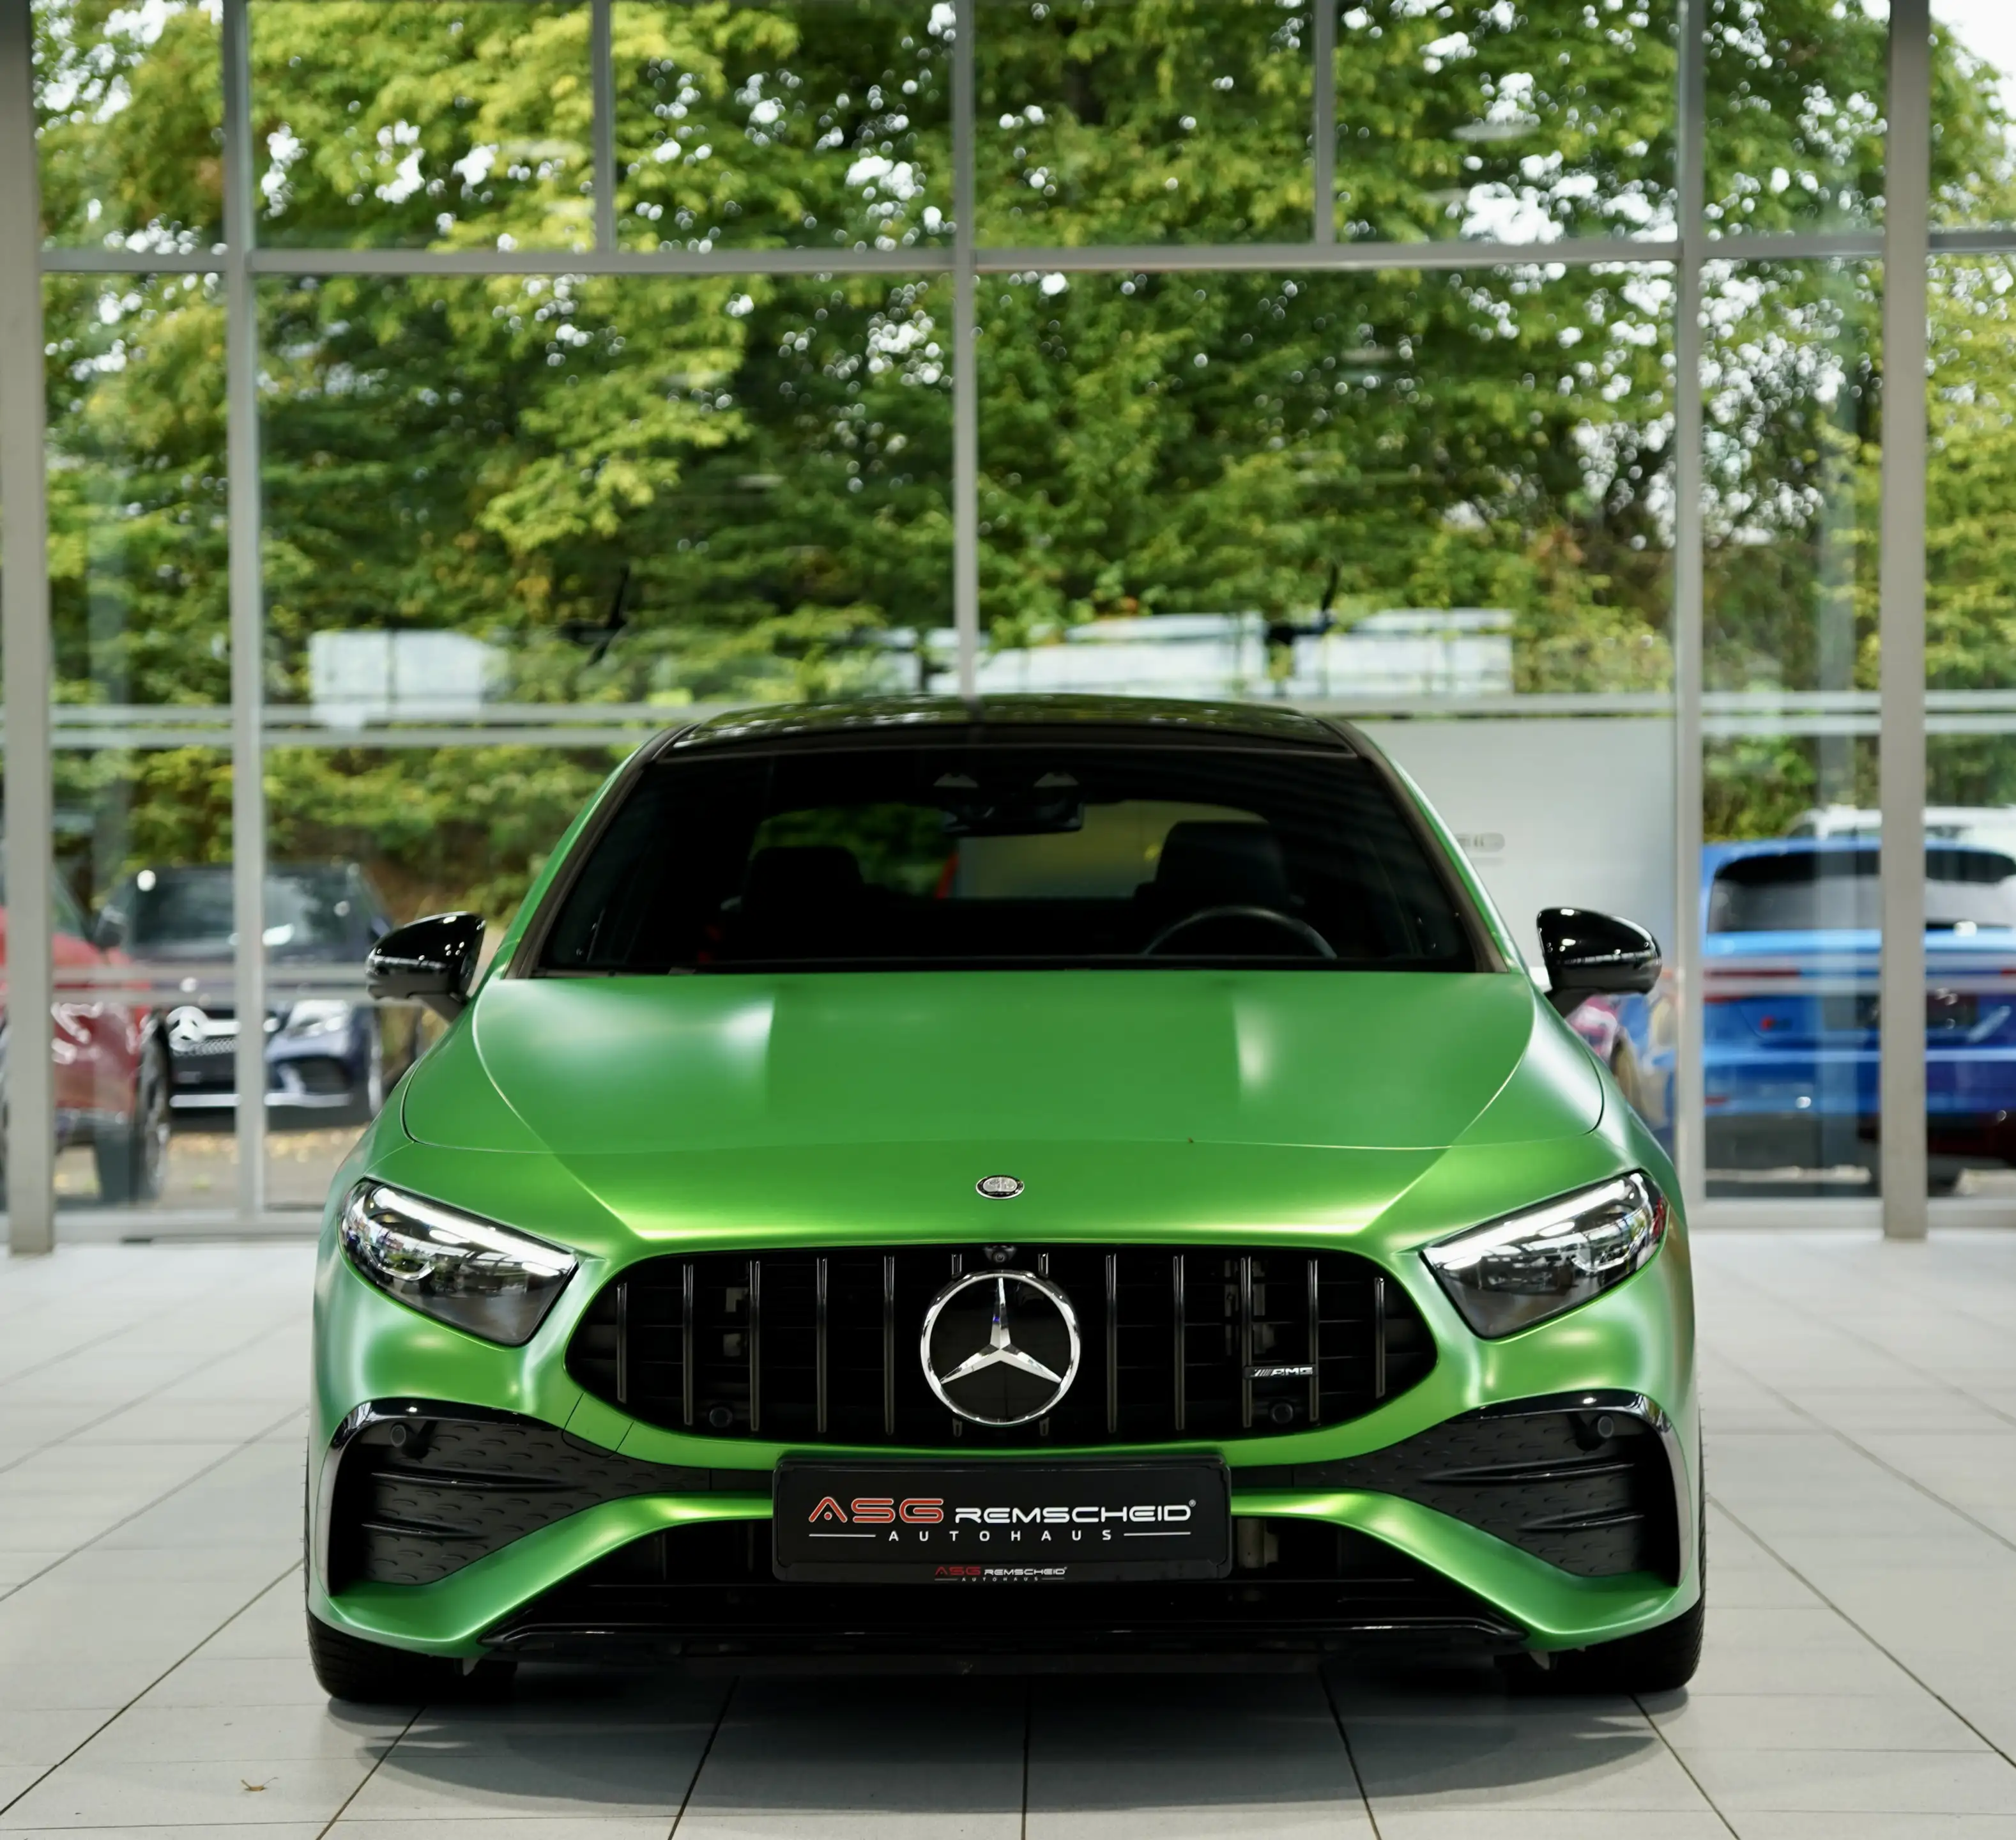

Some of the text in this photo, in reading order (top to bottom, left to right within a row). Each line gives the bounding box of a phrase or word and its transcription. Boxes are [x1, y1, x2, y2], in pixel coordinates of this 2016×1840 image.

[809, 1496, 944, 1524] ASG
[889, 1529, 1111, 1542] AUTOHAUS
[935, 1566, 981, 1575] ASG
